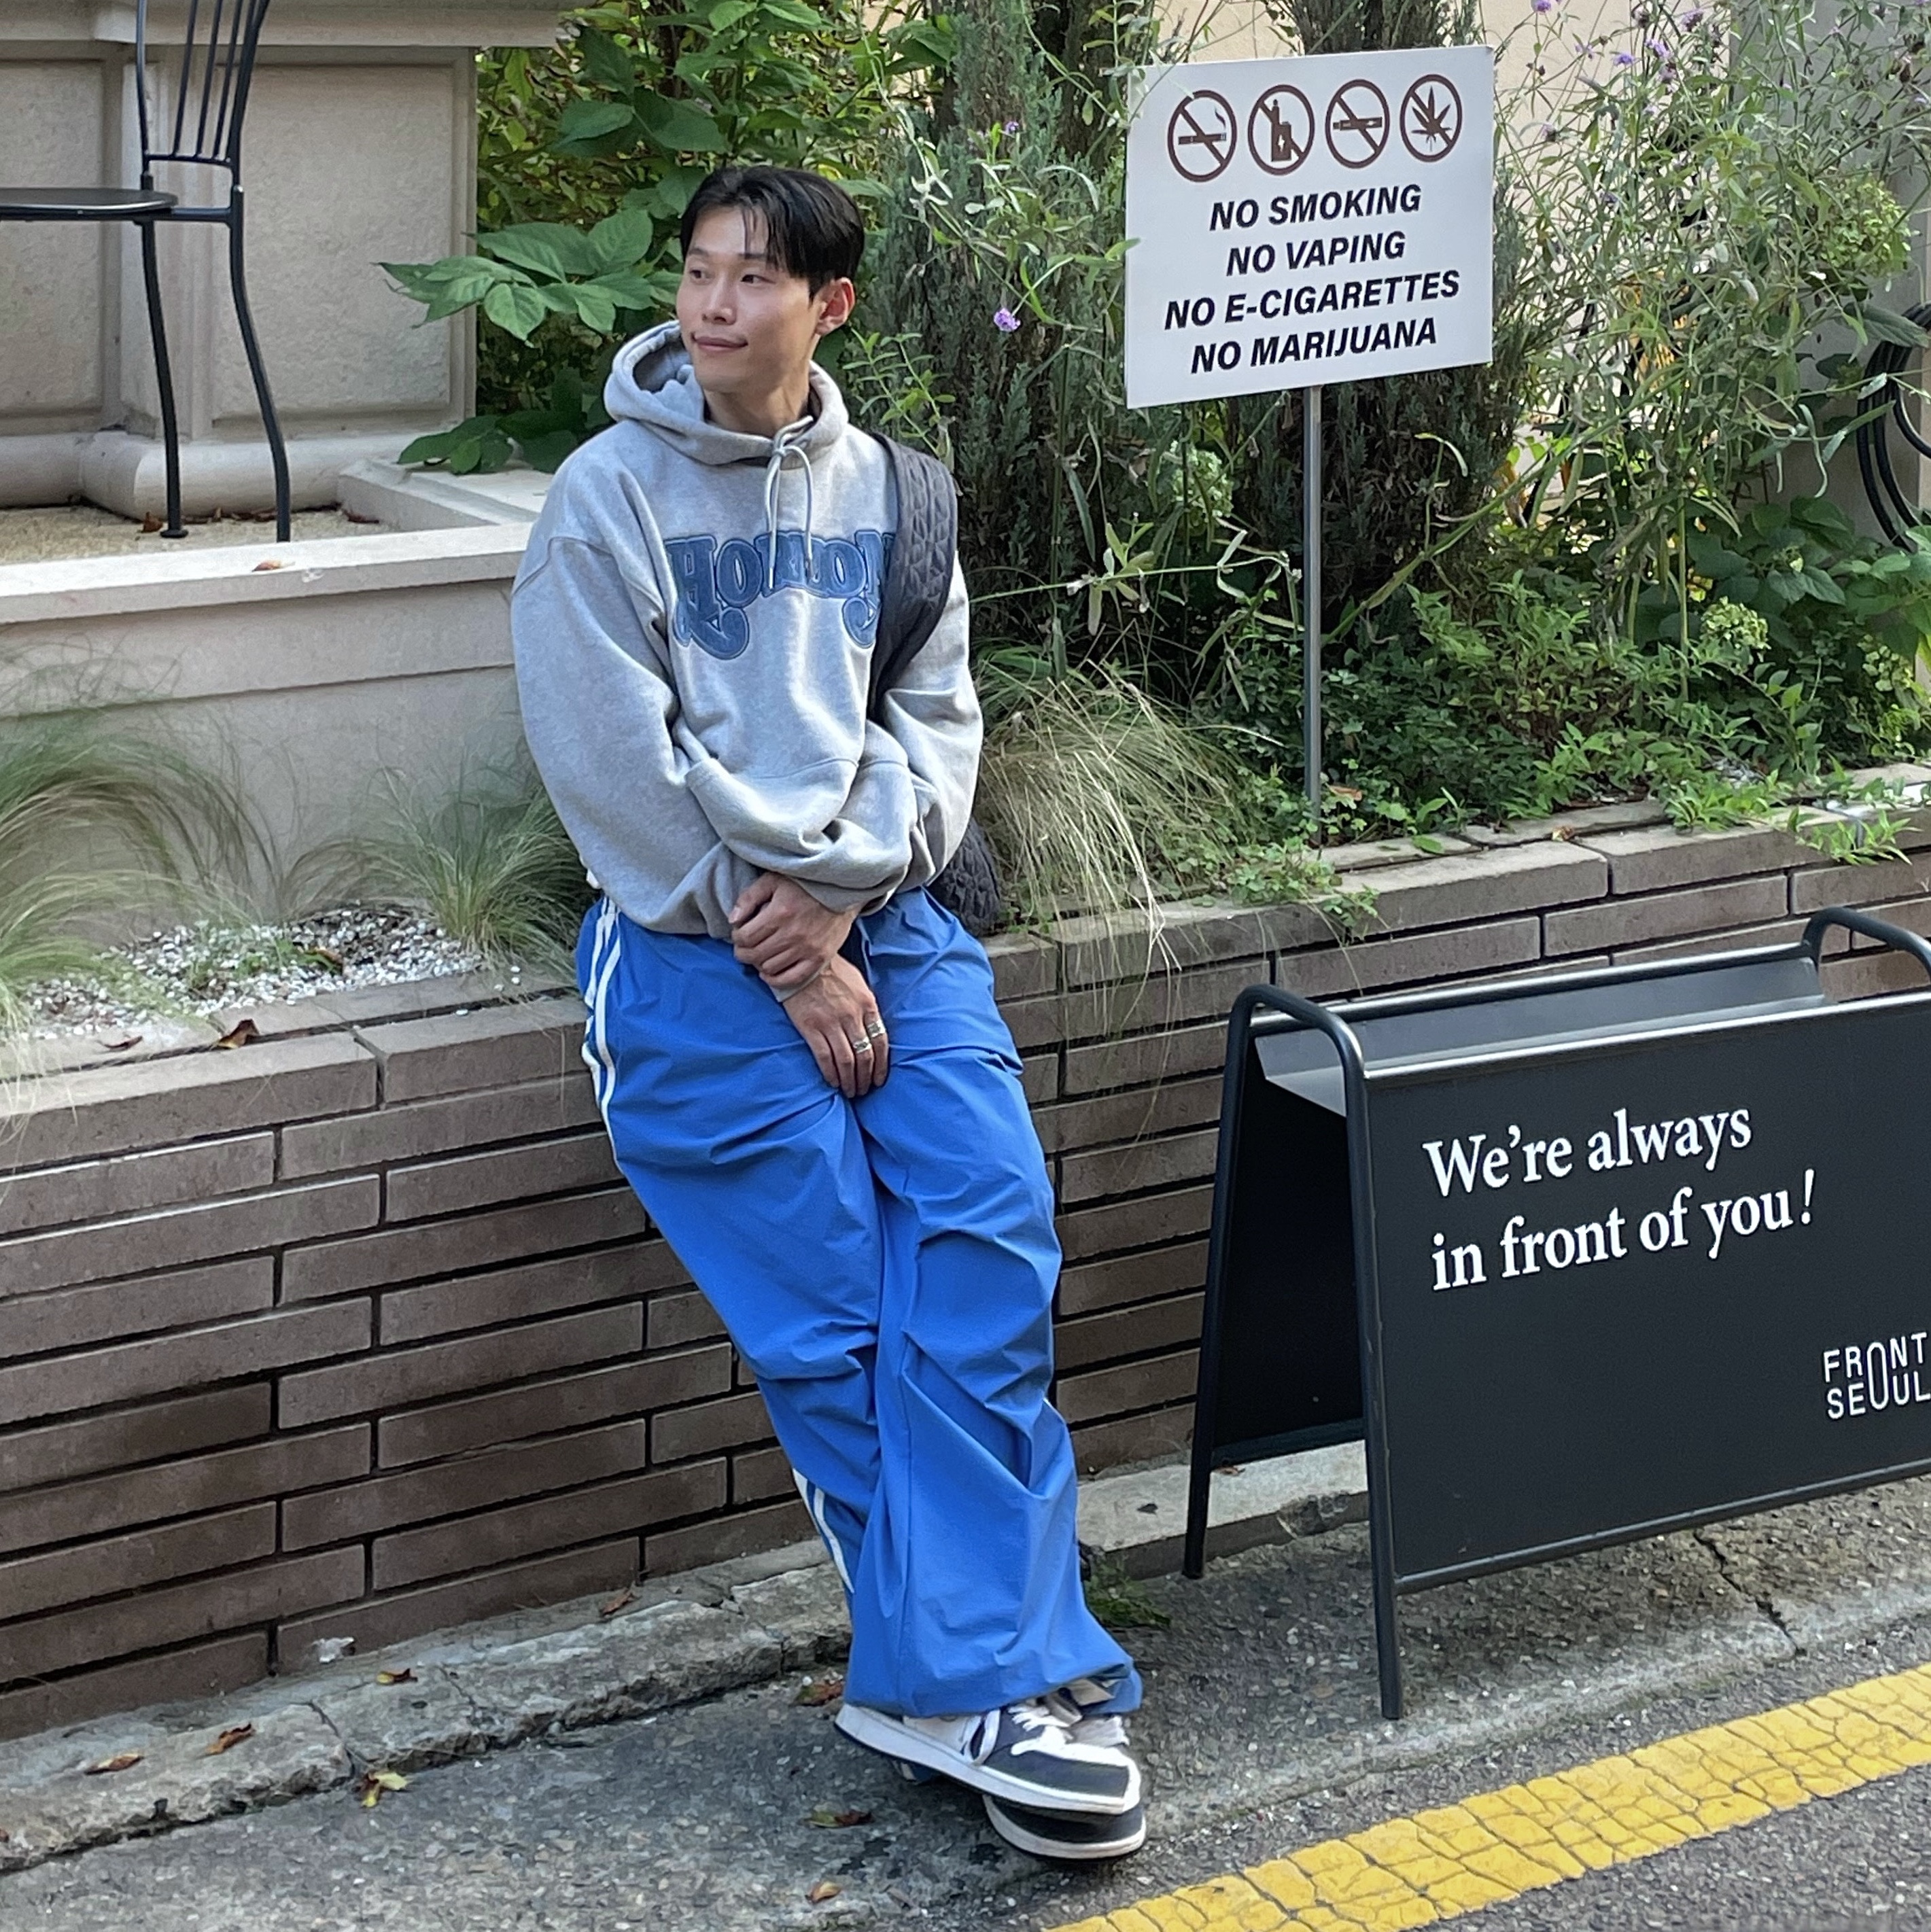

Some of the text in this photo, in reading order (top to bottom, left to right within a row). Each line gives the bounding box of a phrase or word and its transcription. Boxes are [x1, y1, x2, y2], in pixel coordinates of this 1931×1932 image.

[1209, 183, 1421, 231] NO SMOKING
[1226, 230, 1406, 277] NO VAPING
[1164, 270, 1460, 330] NO E-CIGARETTES
[1191, 317, 1436, 374] NO MARIJUANA
[1422, 1108, 1751, 1197] We’re always
[1431, 1233, 1486, 1290] in
[1499, 1207, 1627, 1278] front
[1639, 1187, 1692, 1251] of
[1823, 1332, 1927, 1409] FRONT
[1827, 1342, 1931, 1419] SEOUL
